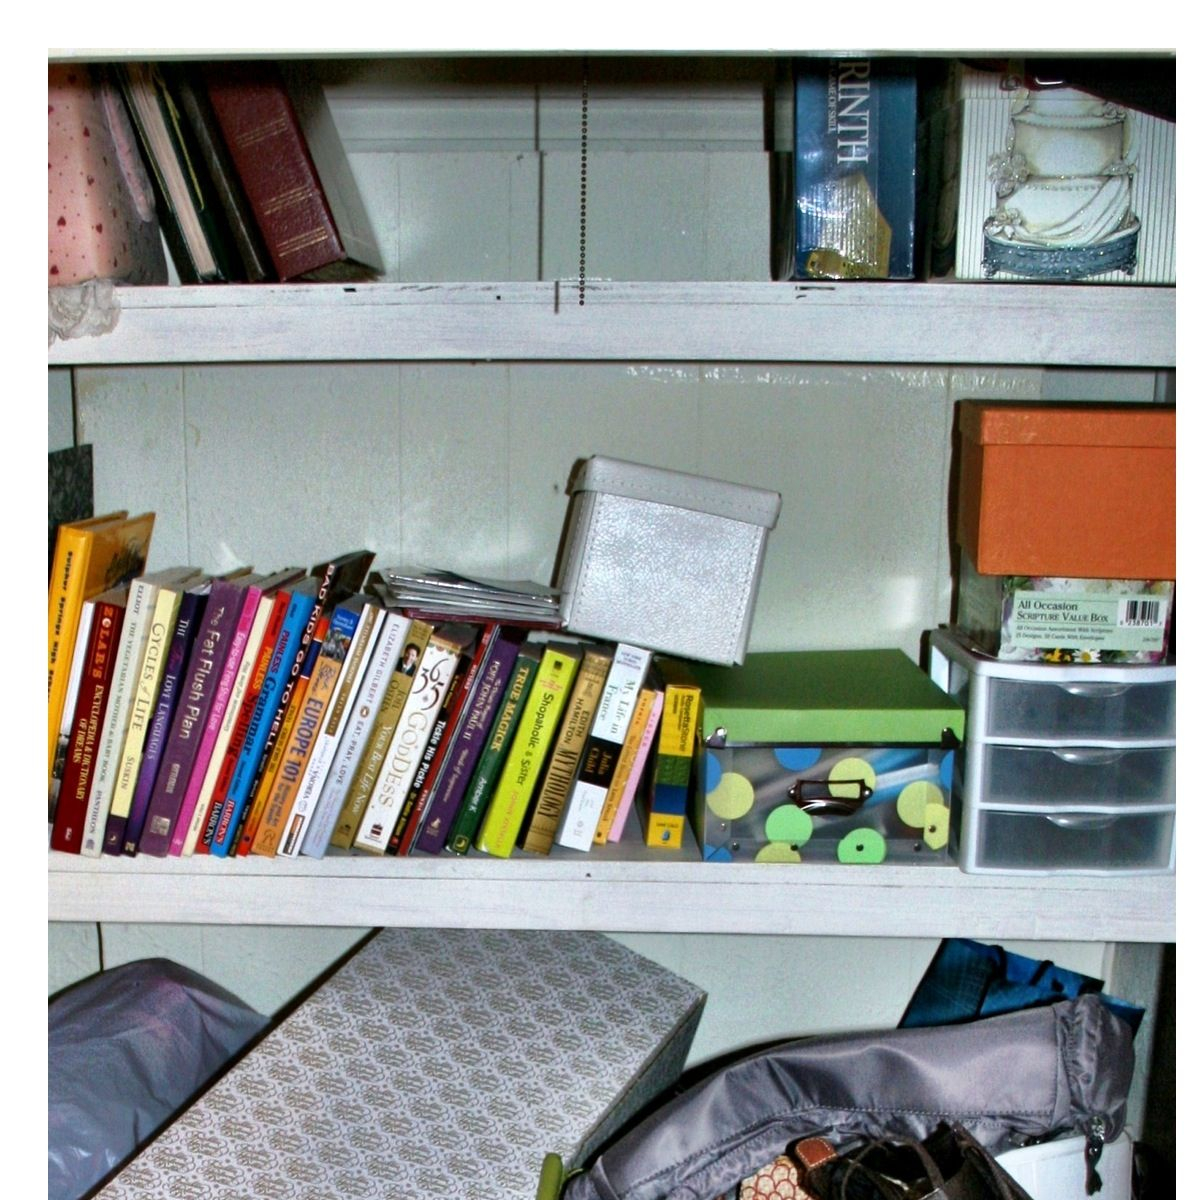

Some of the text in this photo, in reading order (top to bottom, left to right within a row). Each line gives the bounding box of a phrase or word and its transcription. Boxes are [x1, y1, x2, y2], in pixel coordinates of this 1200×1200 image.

[61, 551, 73, 590] Sulphur
[54, 597, 65, 635] Springs
[132, 585, 143, 614] ELLIOT
[1018, 600, 1078, 611] All Occasion
[50, 642, 58, 663] High
[93, 606, 113, 678] ZOLAR'S
[143, 622, 166, 680] CYCLES
[265, 564, 334, 751] BAD KIDS GO TO HELL
[271, 629, 289, 673] PAINLESS
[379, 623, 400, 667] ELIZABETH
[180, 605, 224, 739] The Fat Flush Plan
[252, 646, 273, 690] PAINLESS
[366, 669, 383, 702] GILBERT
[510, 666, 529, 701] TRUE
[162, 674, 175, 698] LOVE
[474, 682, 492, 708] JOHN
[599, 684, 617, 721] France
[621, 678, 635, 697] My
[86, 684, 103, 745] ENCYCLOPEDIA
[133, 698, 149, 730] LIFE
[243, 675, 277, 756] Grammar
[467, 710, 480, 729] PAUL
[491, 701, 516, 751] MAGICK
[525, 692, 554, 748] Shopaholic
[564, 697, 584, 744] HAMILTON
[575, 710, 589, 736] EDITH
[610, 722, 621, 734] in
[615, 700, 628, 721] Life
[73, 718, 86, 763] OF DREAMS
[148, 702, 169, 760] LANGUAGES
[282, 697, 323, 782] EUROPE 101
[430, 719, 445, 744] Tickle
[423, 746, 435, 761] His
[585, 747, 599, 772] Child
[598, 752, 611, 774] Julia
[76, 753, 90, 800] DICTIONARY
[121, 756, 134, 789] SUSKIN
[304, 769, 318, 799] VERONA
[335, 765, 347, 784] LOVE
[413, 761, 429, 788] Pickle
[515, 758, 531, 785] Sister
[539, 746, 577, 820] MYTHOLOGY
[472, 776, 487, 804] Amber
[203, 801, 222, 844] BARRON'S
[215, 800, 234, 843] BARRON'S
